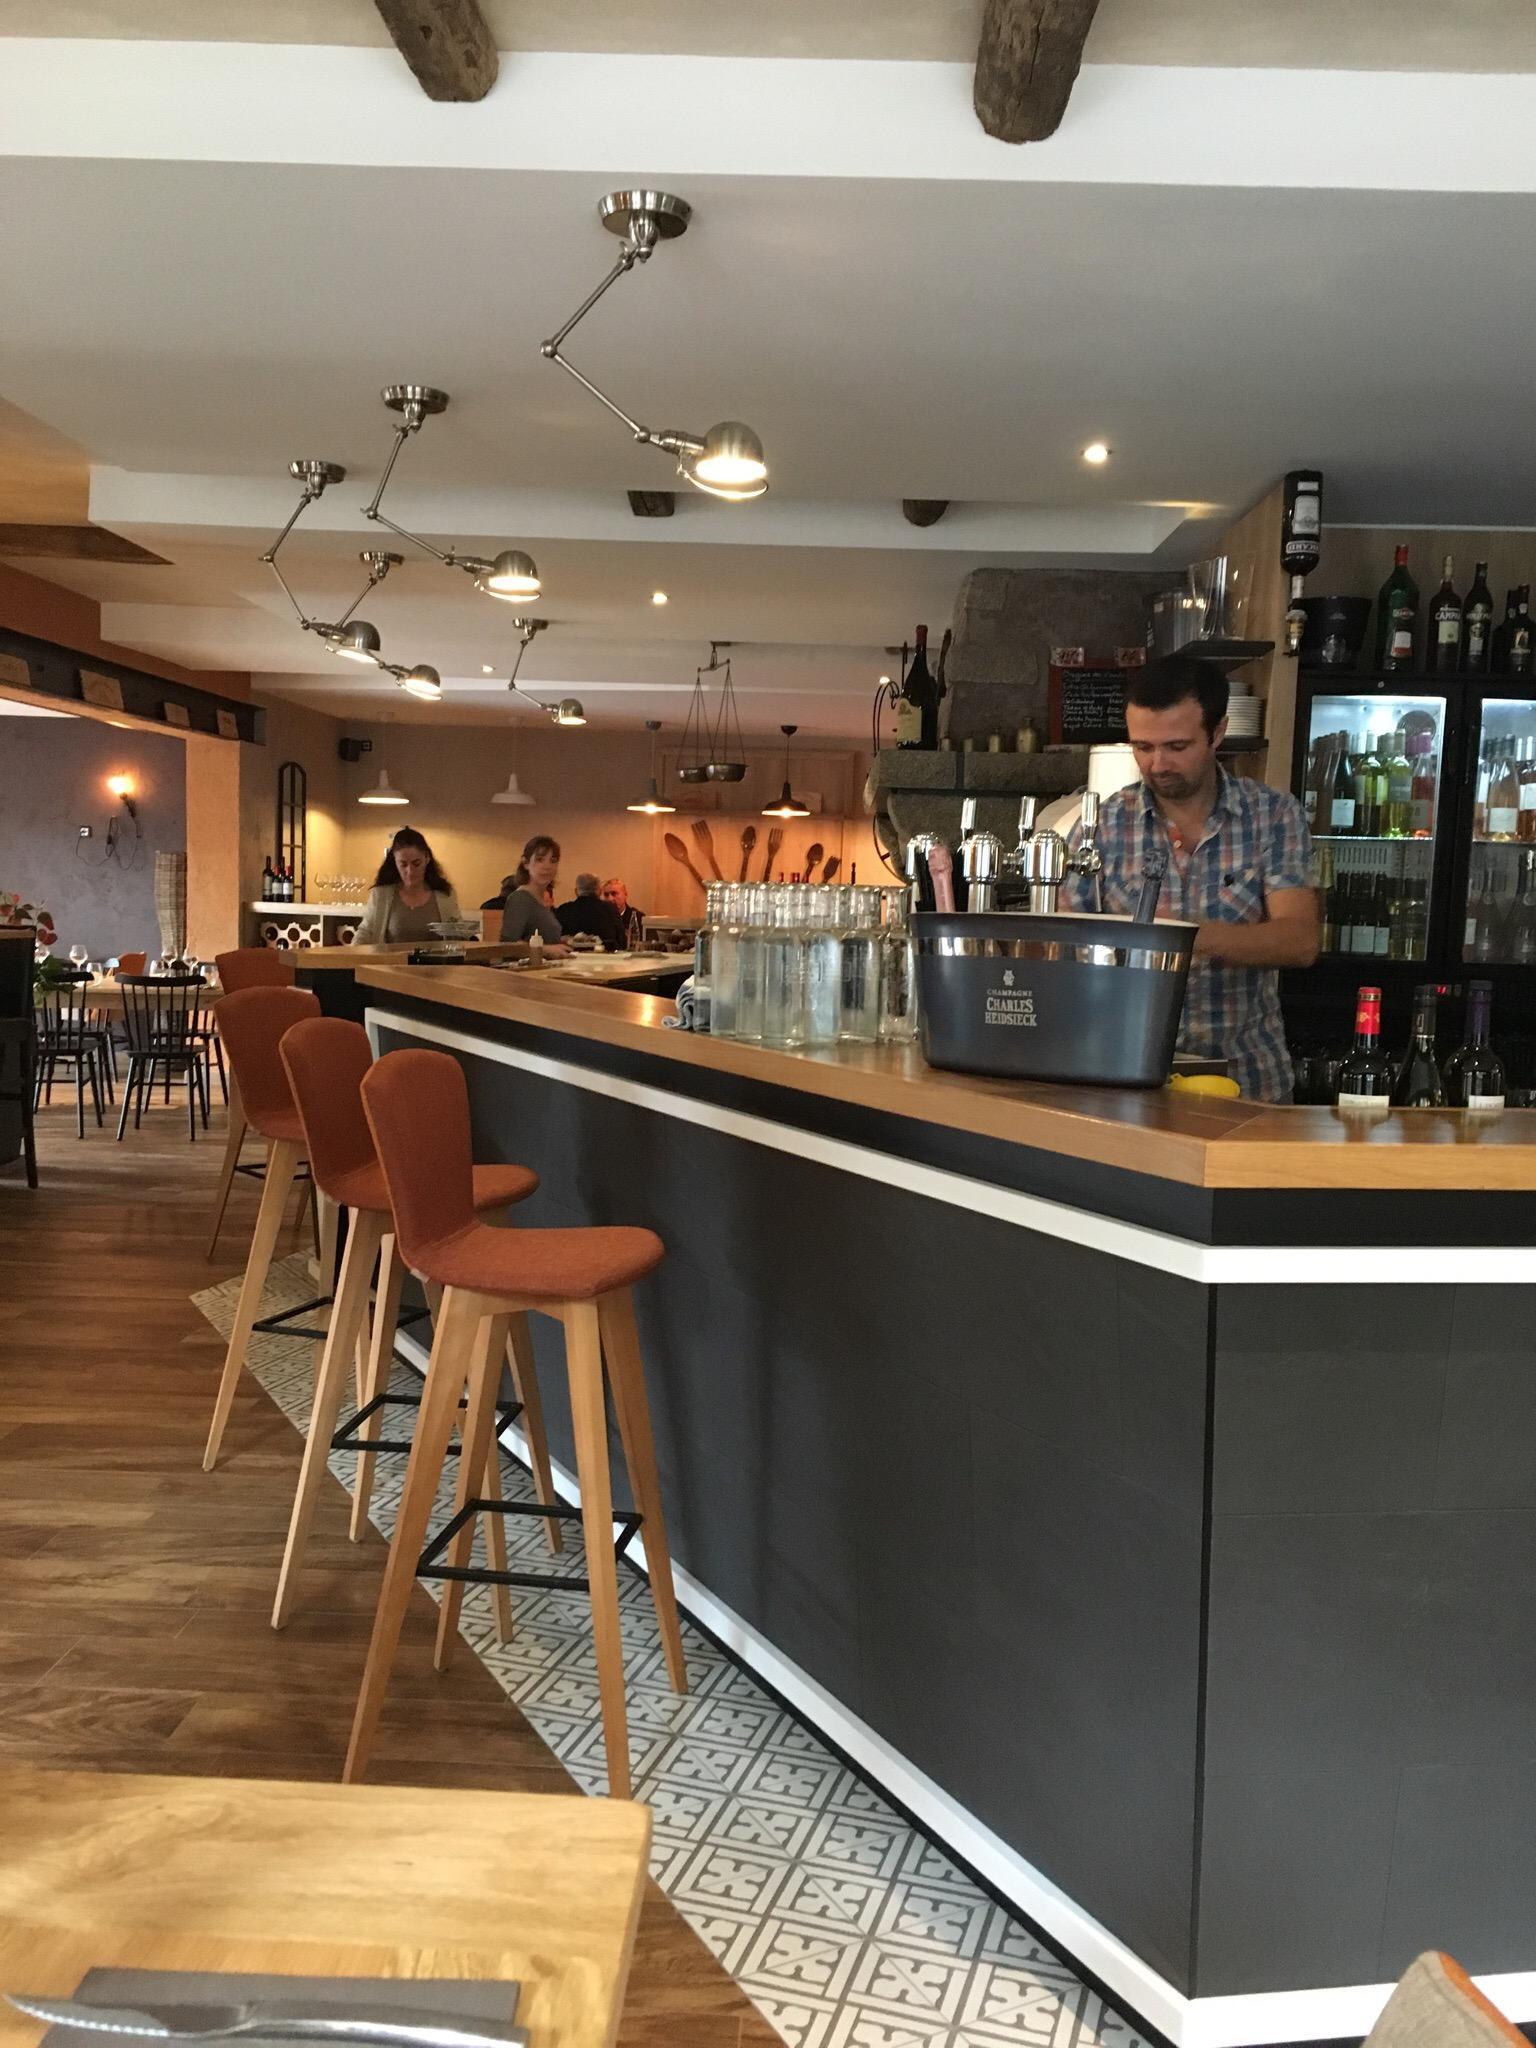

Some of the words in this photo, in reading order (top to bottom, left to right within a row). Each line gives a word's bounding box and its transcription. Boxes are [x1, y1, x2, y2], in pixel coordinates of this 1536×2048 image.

[987, 988, 1032, 996] CHAMPAGNE
[986, 997, 1033, 1013] CHARLES
[985, 1011, 1037, 1026] HEIDSIECK
